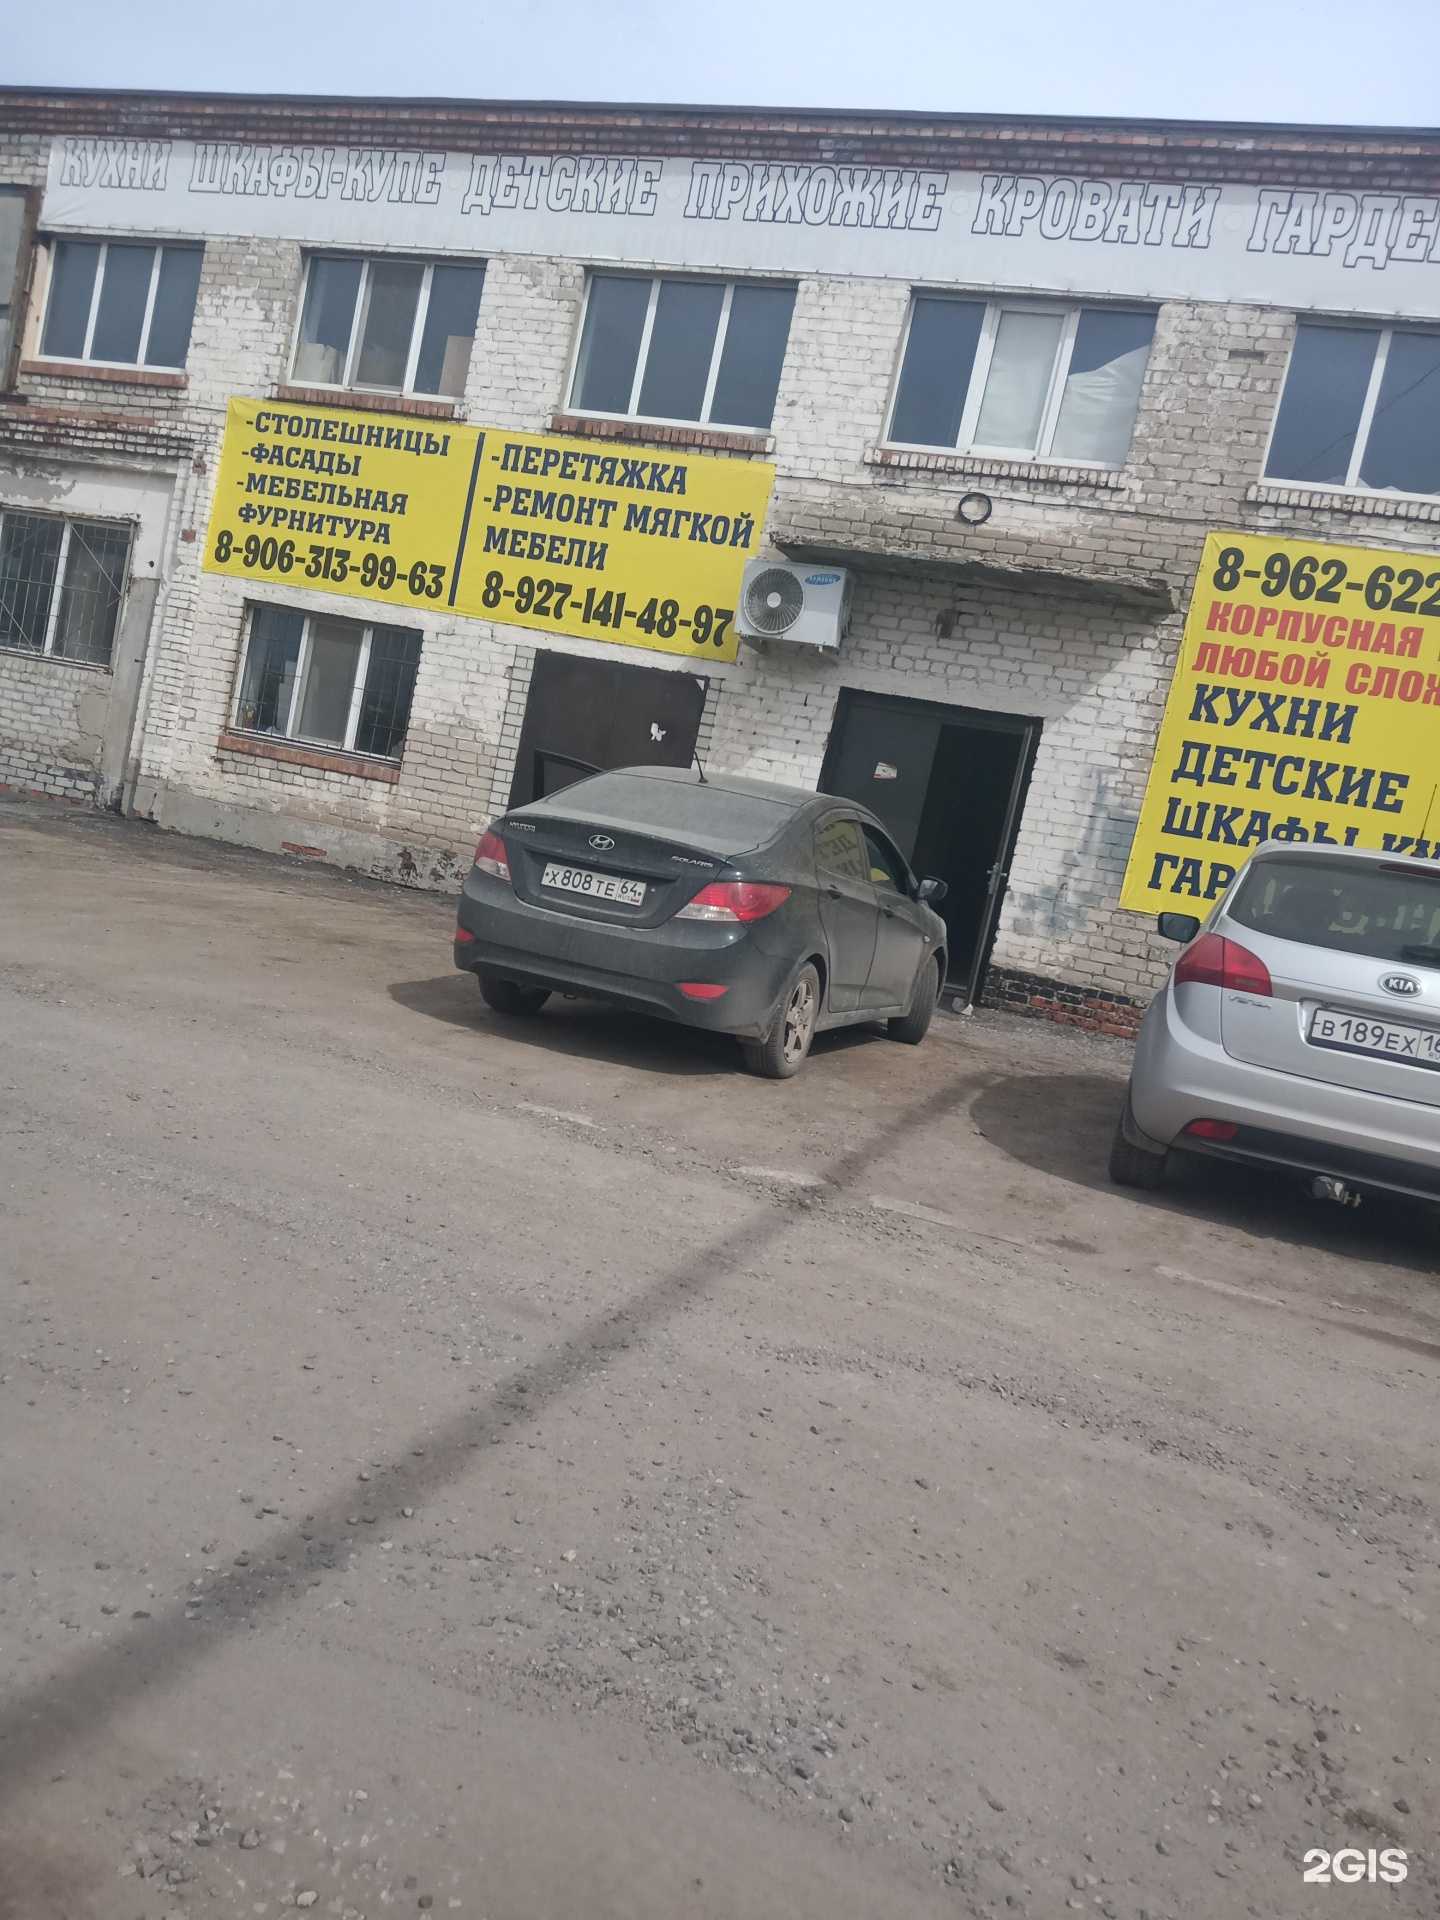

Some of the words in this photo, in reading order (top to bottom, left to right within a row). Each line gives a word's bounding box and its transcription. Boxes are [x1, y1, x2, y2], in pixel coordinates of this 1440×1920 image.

[58, 137, 172, 190] КУХНИ
[188, 144, 447, 204] ШКАФЫ-КУПЕ
[461, 153, 663, 216] ДЕТСКИЕ
[683, 161, 949, 231] ПРИХОЖИЕ
[971, 174, 1222, 248] КРОВАТИ
[1246, 188, 1440, 270] ГАРДЕ
[246, 411, 451, 456] -СТОЛЕШНИЦЫ
[242, 442, 362, 477] -ФАСАДЫ
[491, 443, 688, 495] -ПЕРЕТЯЖКА
[237, 472, 409, 515] -МЕБЕЛЬНАЯ
[483, 484, 617, 528] -РЕМОНТ
[623, 503, 755, 549] МЯГКОЙ
[238, 502, 391, 545] ФУРНИТУРА
[483, 525, 609, 571] МЕБЕЛИ
[214, 530, 447, 599] 8-906-313-99-63
[481, 570, 736, 648] 8-927-141-48-97
[1206, 601, 1424, 658] КОРПУСНАЯ
[1192, 642, 1331, 689] ЛЮБОЙ
[1189, 683, 1359, 744] КУХНИ
[1171, 740, 1410, 813] ДЕТСКИЕ
[1161, 797, 1360, 848] ШКАФЫ
[1388, 978, 1415, 993] KIA
